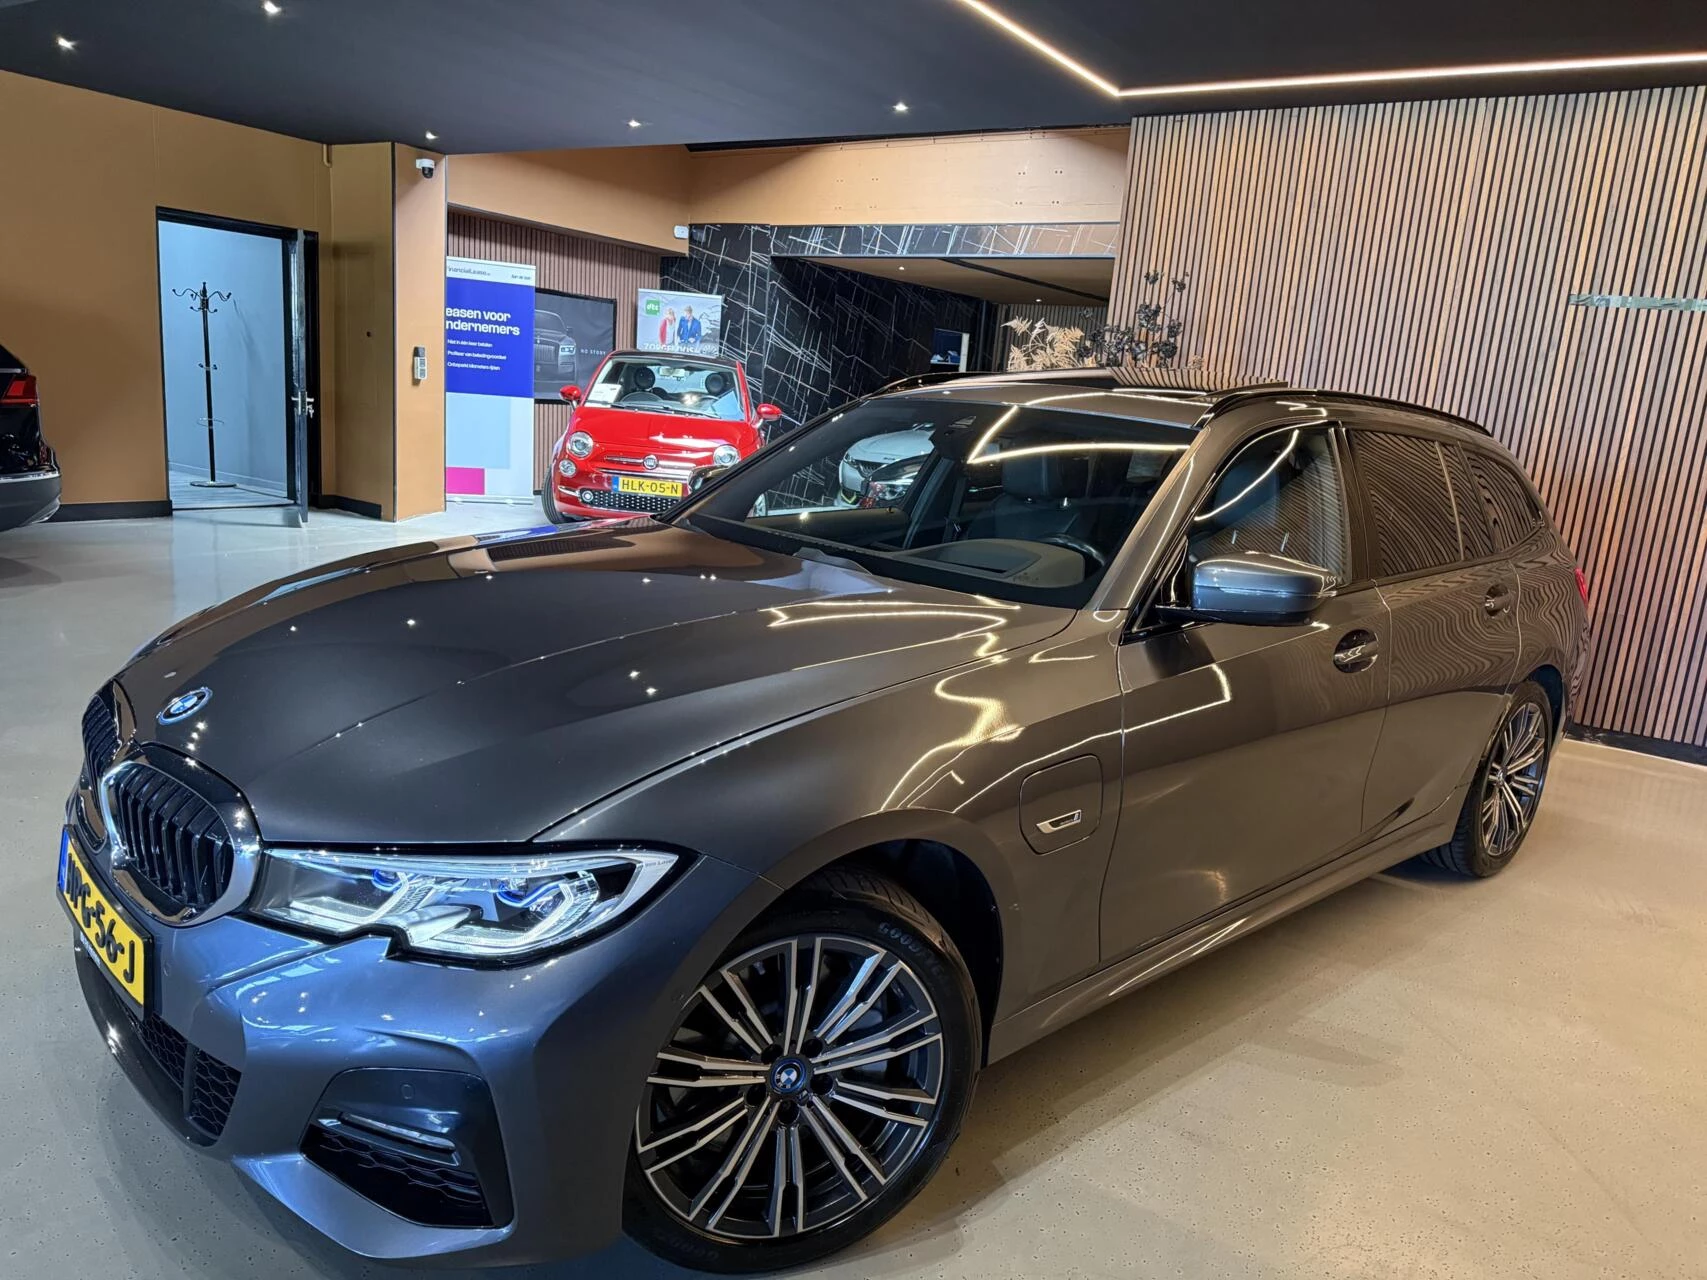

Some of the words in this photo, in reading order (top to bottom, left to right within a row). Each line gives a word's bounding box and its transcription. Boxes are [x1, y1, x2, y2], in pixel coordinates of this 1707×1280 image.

[446, 308, 481, 319] easen
[483, 311, 511, 322] voor
[446, 320, 520, 335] ndernemers
[622, 479, 679, 494] HLK-05-N
